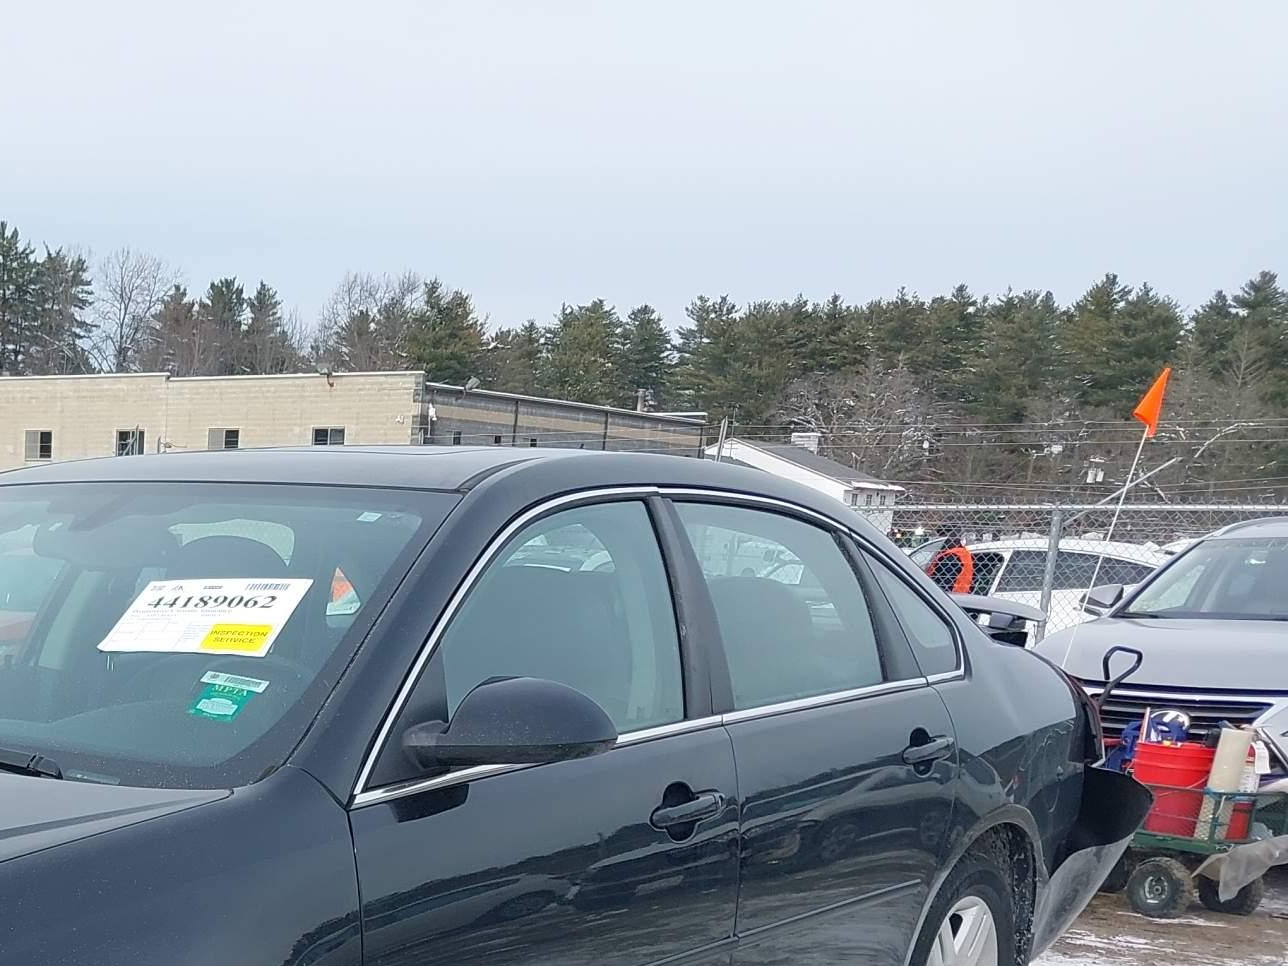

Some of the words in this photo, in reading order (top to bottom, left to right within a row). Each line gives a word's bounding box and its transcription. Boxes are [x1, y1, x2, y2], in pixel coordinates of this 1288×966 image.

[147, 595, 278, 609] 44189062
[210, 630, 268, 638] INSPECTION
[212, 636, 257, 644] SERVICE
